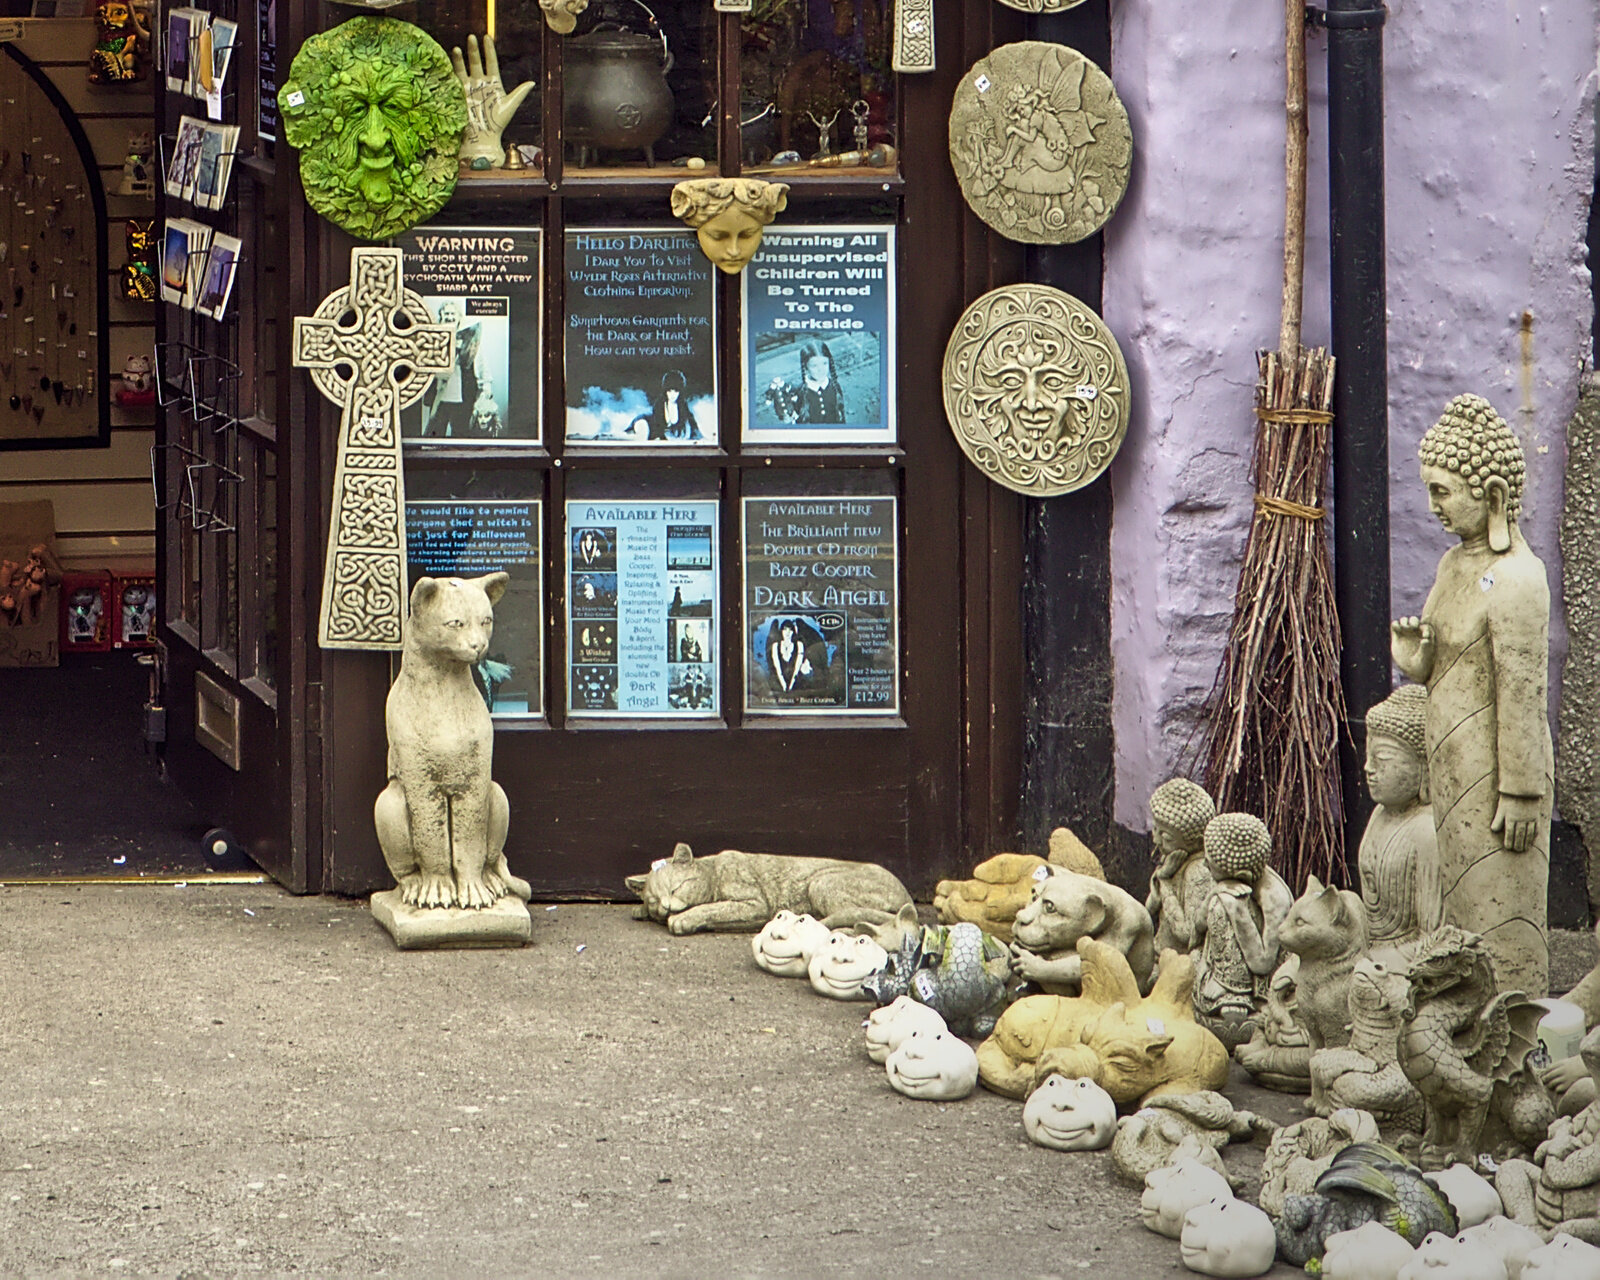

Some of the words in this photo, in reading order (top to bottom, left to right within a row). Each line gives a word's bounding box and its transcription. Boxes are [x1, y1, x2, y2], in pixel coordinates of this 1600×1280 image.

[416, 236, 514, 252] WARNING
[762, 235, 844, 248] Warning
[851, 235, 877, 246] All
[752, 252, 887, 264] Unsupervised
[439, 264, 473, 273] CCTV
[755, 269, 839, 279] Children
[846, 269, 882, 279] Will
[436, 284, 467, 292] SHARP
[470, 284, 492, 292] AXE
[768, 285, 794, 296] Be
[800, 285, 871, 296] Turned
[785, 302, 809, 312] To
[815, 302, 854, 312] The
[775, 318, 864, 329] Darkside
[817, 543, 840, 555] CD
[855, 691, 889, 702] £12.99
